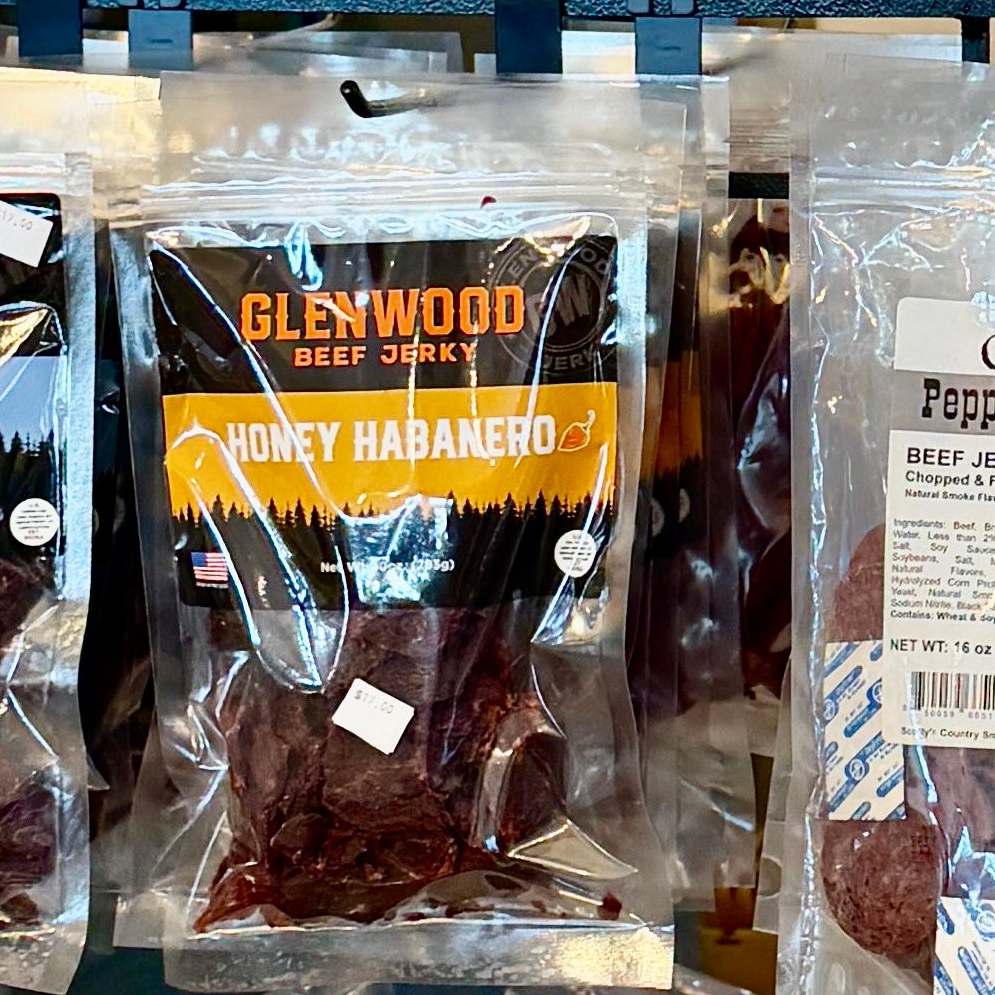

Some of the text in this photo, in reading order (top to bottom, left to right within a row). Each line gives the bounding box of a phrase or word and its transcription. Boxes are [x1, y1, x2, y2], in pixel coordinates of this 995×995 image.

[239, 285, 527, 341] GLENWOOD
[294, 342, 478, 367] BEEF JERKY
[922, 377, 995, 430] Pepp
[227, 414, 557, 463] HONEY HABANERO
[907, 447, 964, 466] BEEF
[905, 470, 969, 487] Chopped
[974, 474, 984, 486] &
[905, 489, 940, 499] Natural
[942, 491, 975, 501] Smoke
[893, 518, 946, 529] Ingredients:
[928, 531, 949, 540] Less
[956, 534, 976, 542] than
[930, 543, 948, 554] Soy
[892, 564, 923, 573] Natural
[891, 576, 941, 587] Hydrolyzed
[928, 589, 961, 598] Natural
[890, 610, 933, 619] Contains:
[936, 611, 967, 621] Wheat
[890, 639, 992, 654] NET WT: 16 oz
[940, 728, 980, 740] Country
